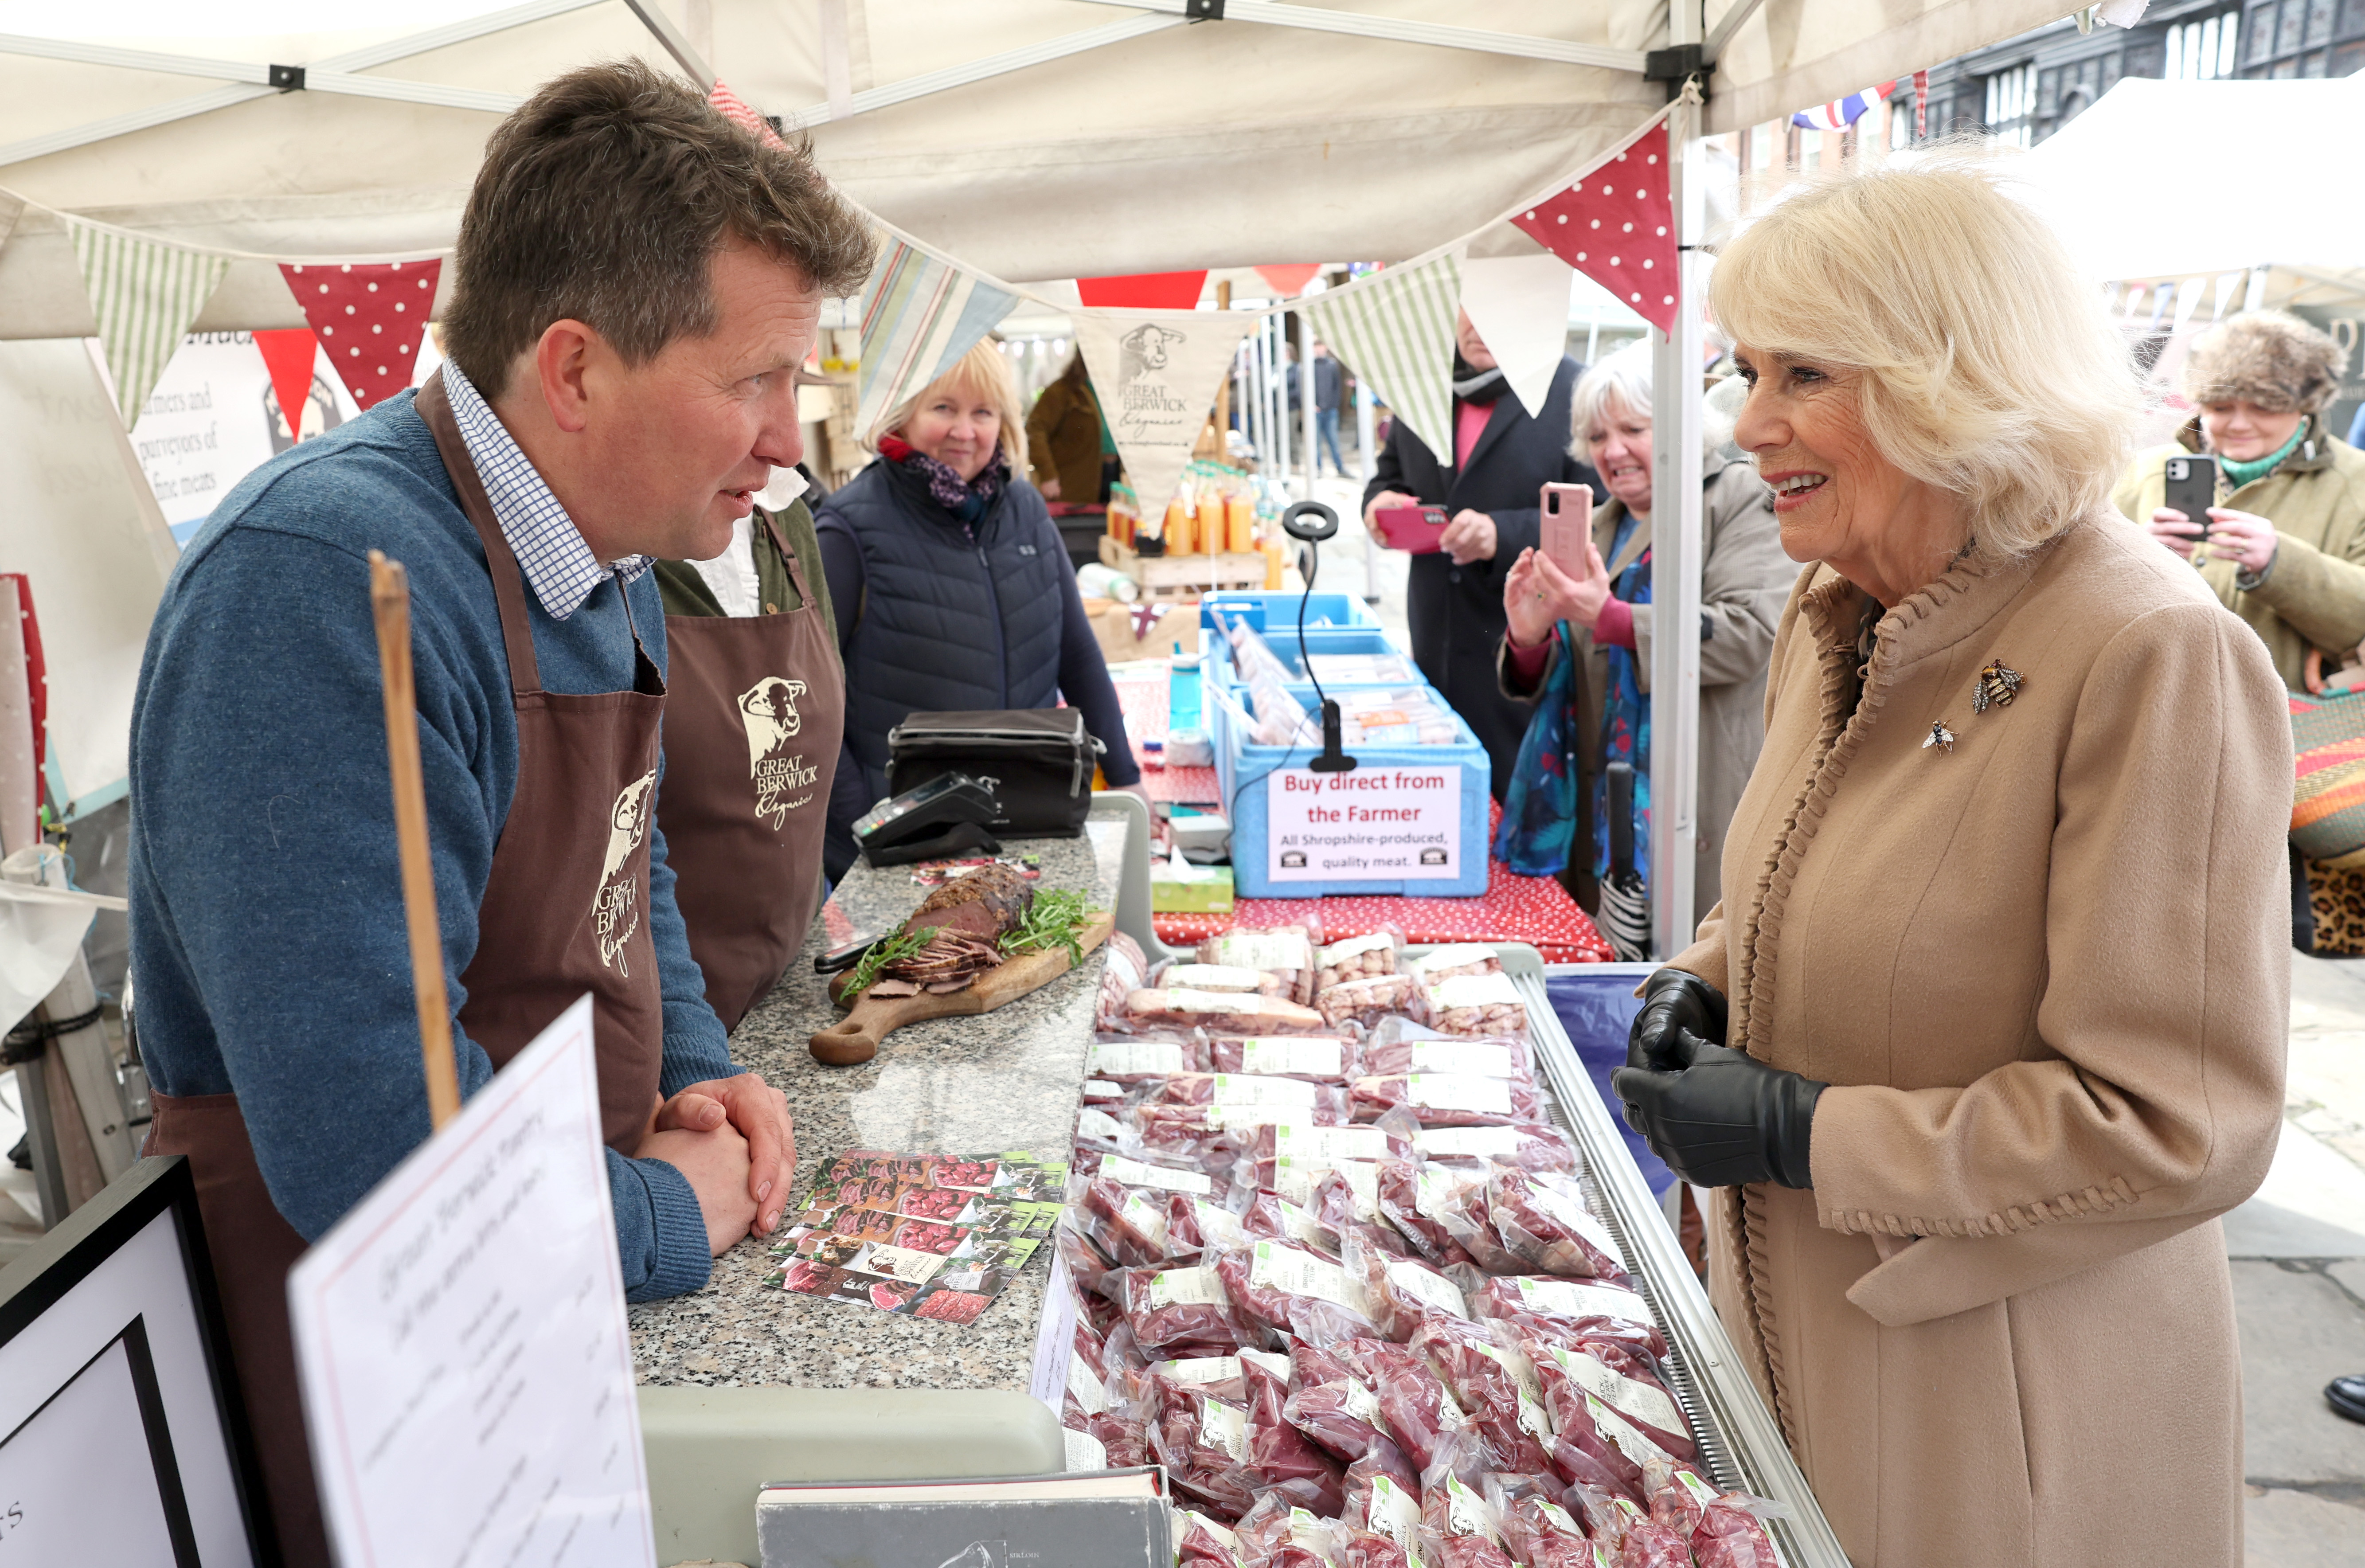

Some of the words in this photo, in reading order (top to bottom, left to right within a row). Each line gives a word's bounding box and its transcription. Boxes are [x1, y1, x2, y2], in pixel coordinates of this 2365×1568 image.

[188, 380, 212, 411] and
[1124, 384, 1166, 397] GREAT
[1124, 398, 1187, 412] BERWICK
[139, 433, 202, 471] purveyors
[204, 420, 219, 450] of
[153, 471, 178, 502] fine
[180, 472, 217, 496] meats
[756, 755, 803, 777] GREAT
[756, 765, 817, 794] BERWICK
[1285, 775, 1322, 794] Buy
[1329, 771, 1388, 790] direct
[1395, 772, 1444, 790] from
[755, 785, 813, 831] Organics
[1308, 806, 1341, 823] the
[1348, 806, 1422, 821] Farmer
[1280, 834, 1298, 845] All
[1302, 832, 1448, 847] Shropshire-produced,
[1322, 856, 1369, 869] quality
[1373, 856, 1411, 867] meat.
[598, 872, 636, 910] GREA
[895, 1259, 912, 1275] GREAT
[902, 1255, 926, 1277] BERWICK
[1598, 1376, 1607, 1400] UCK/
[1603, 1371, 1611, 1404] SEROLE
